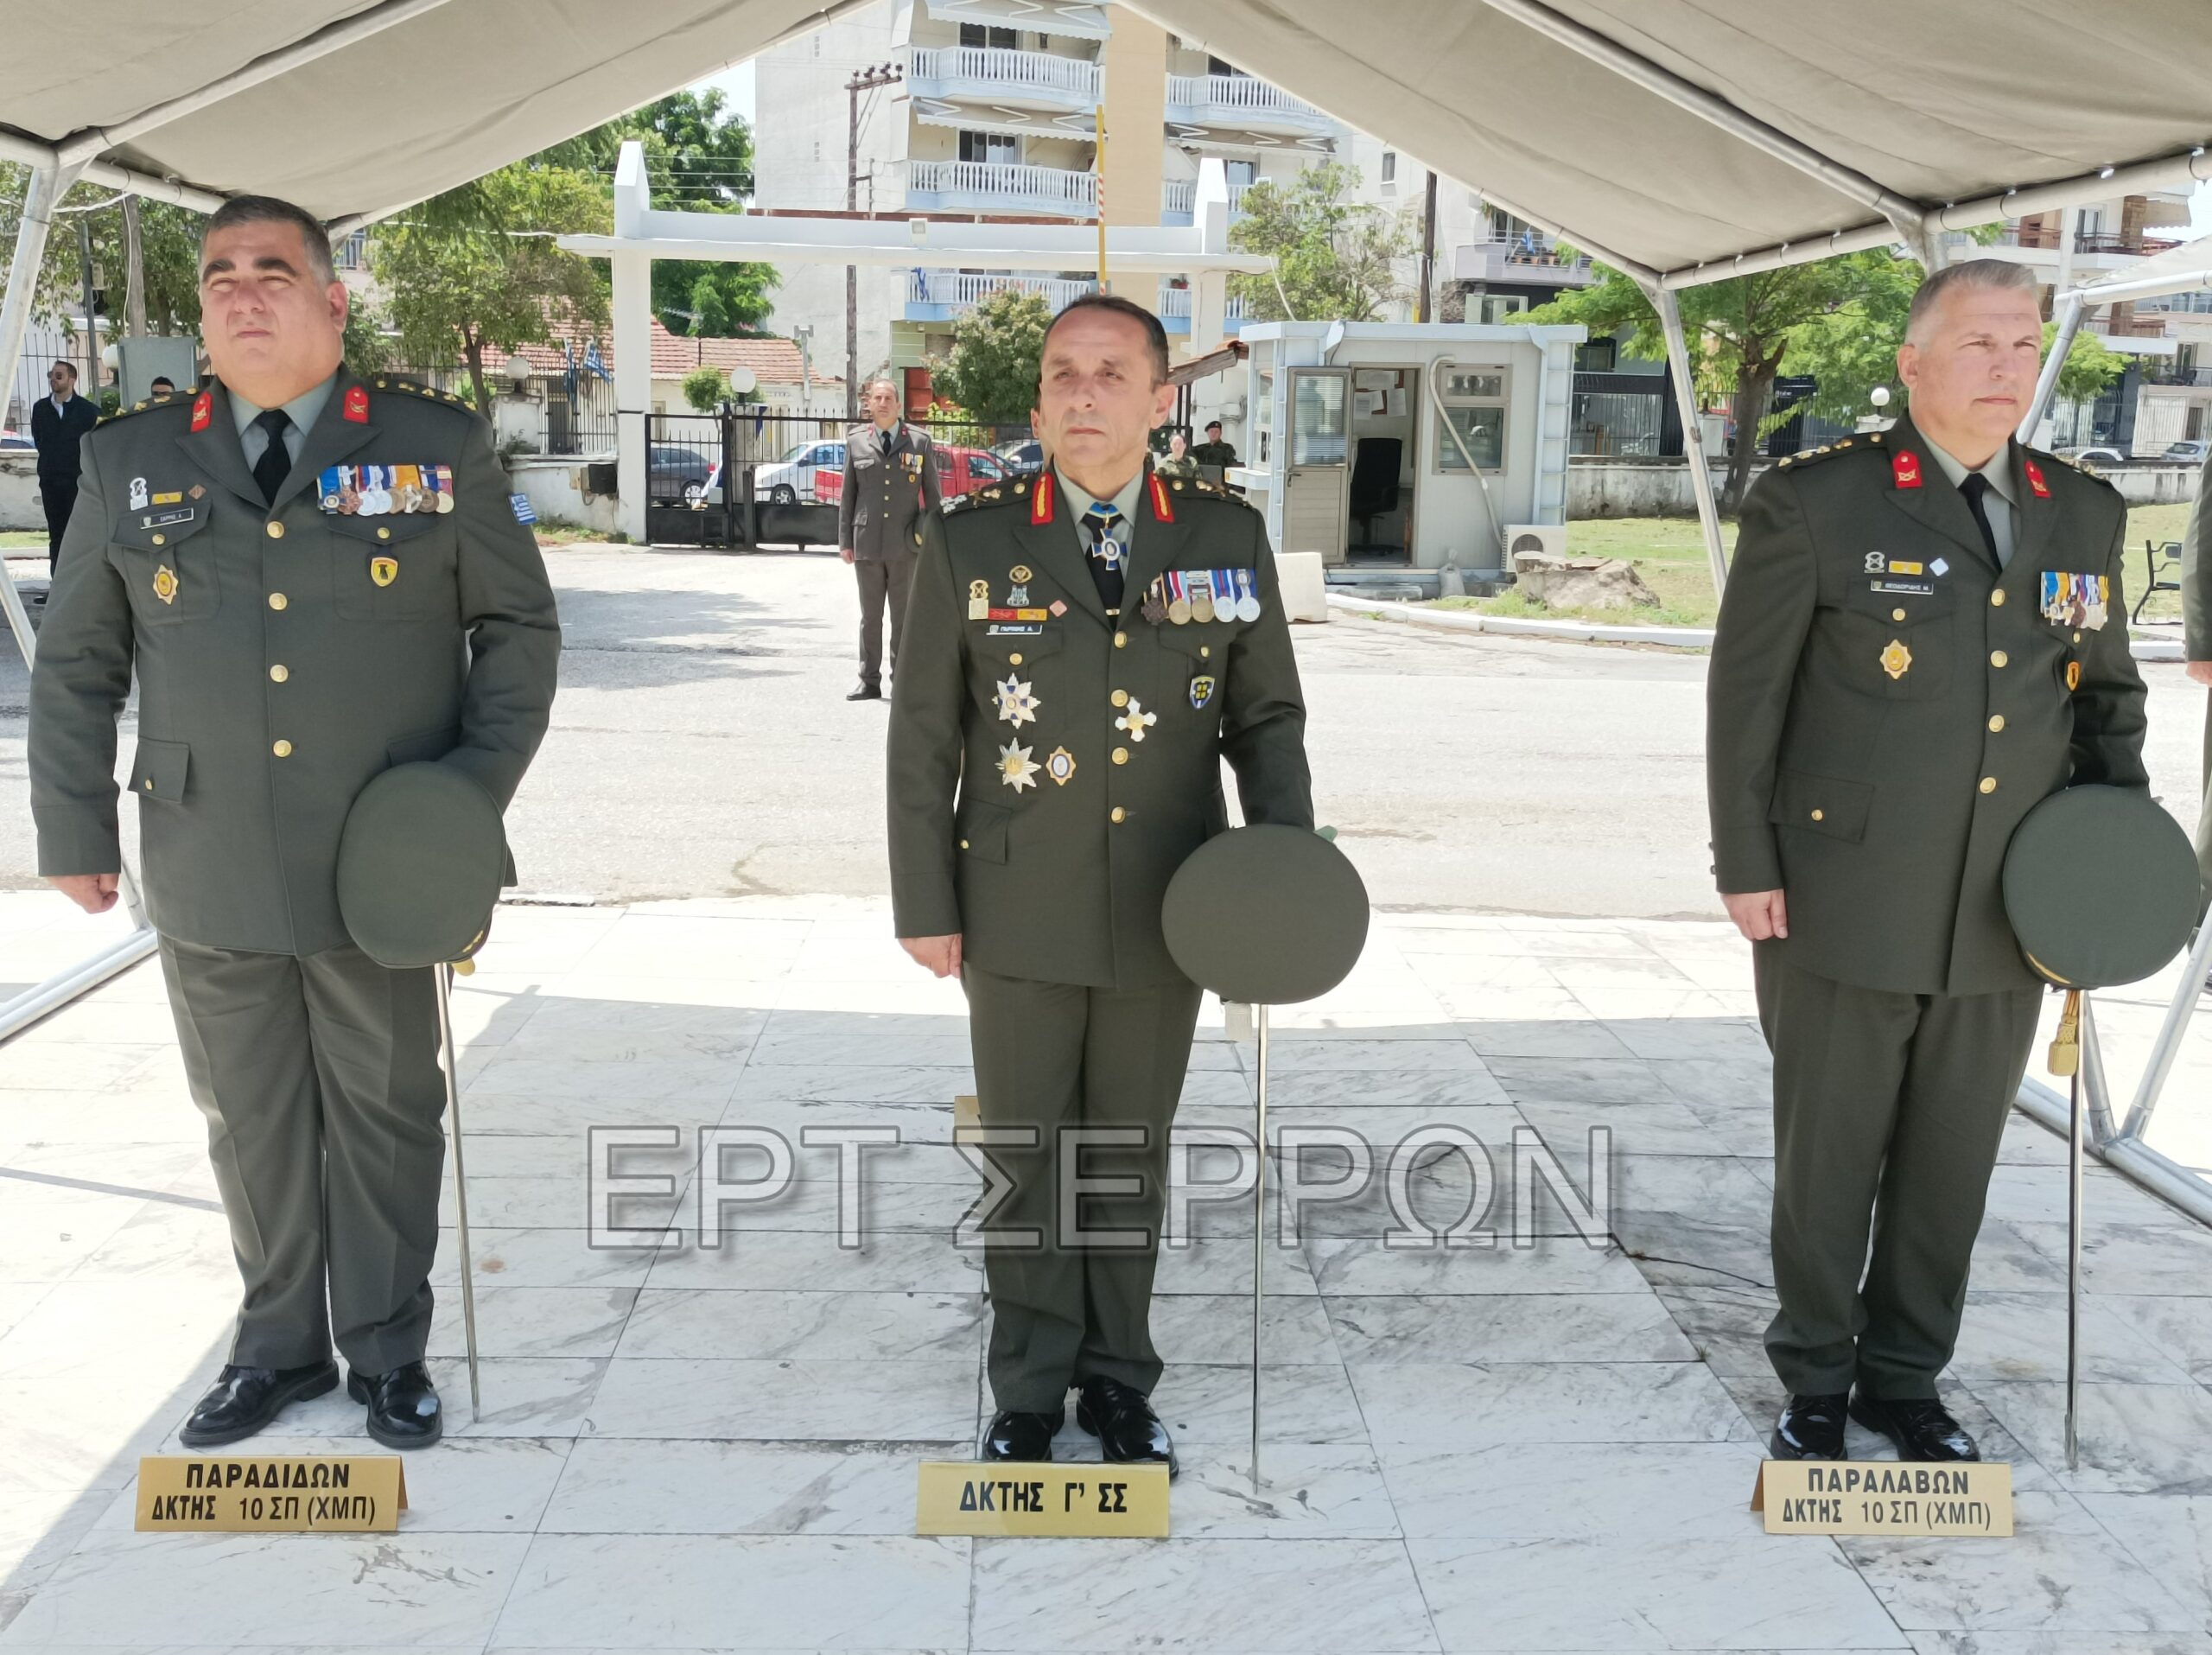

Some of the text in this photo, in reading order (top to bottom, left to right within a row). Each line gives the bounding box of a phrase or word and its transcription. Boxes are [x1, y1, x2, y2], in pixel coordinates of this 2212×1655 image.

[186, 1463, 349, 1488] ΠΑΡΑΔΙΔΩΝ
[1808, 1467, 1968, 1494] ΠΑΡΑΛΑΒΩΝ
[152, 1495, 376, 1525] ΔΚΤΗΣ 10 ΣΠ (ΧΜΠ)
[959, 1481, 1128, 1512] ΔΚΤΗΣ Γ' ΣΣ
[1783, 1498, 1991, 1531] ΔΚΤΗΣ 10 ΣΠ (ΧΜΠ)
